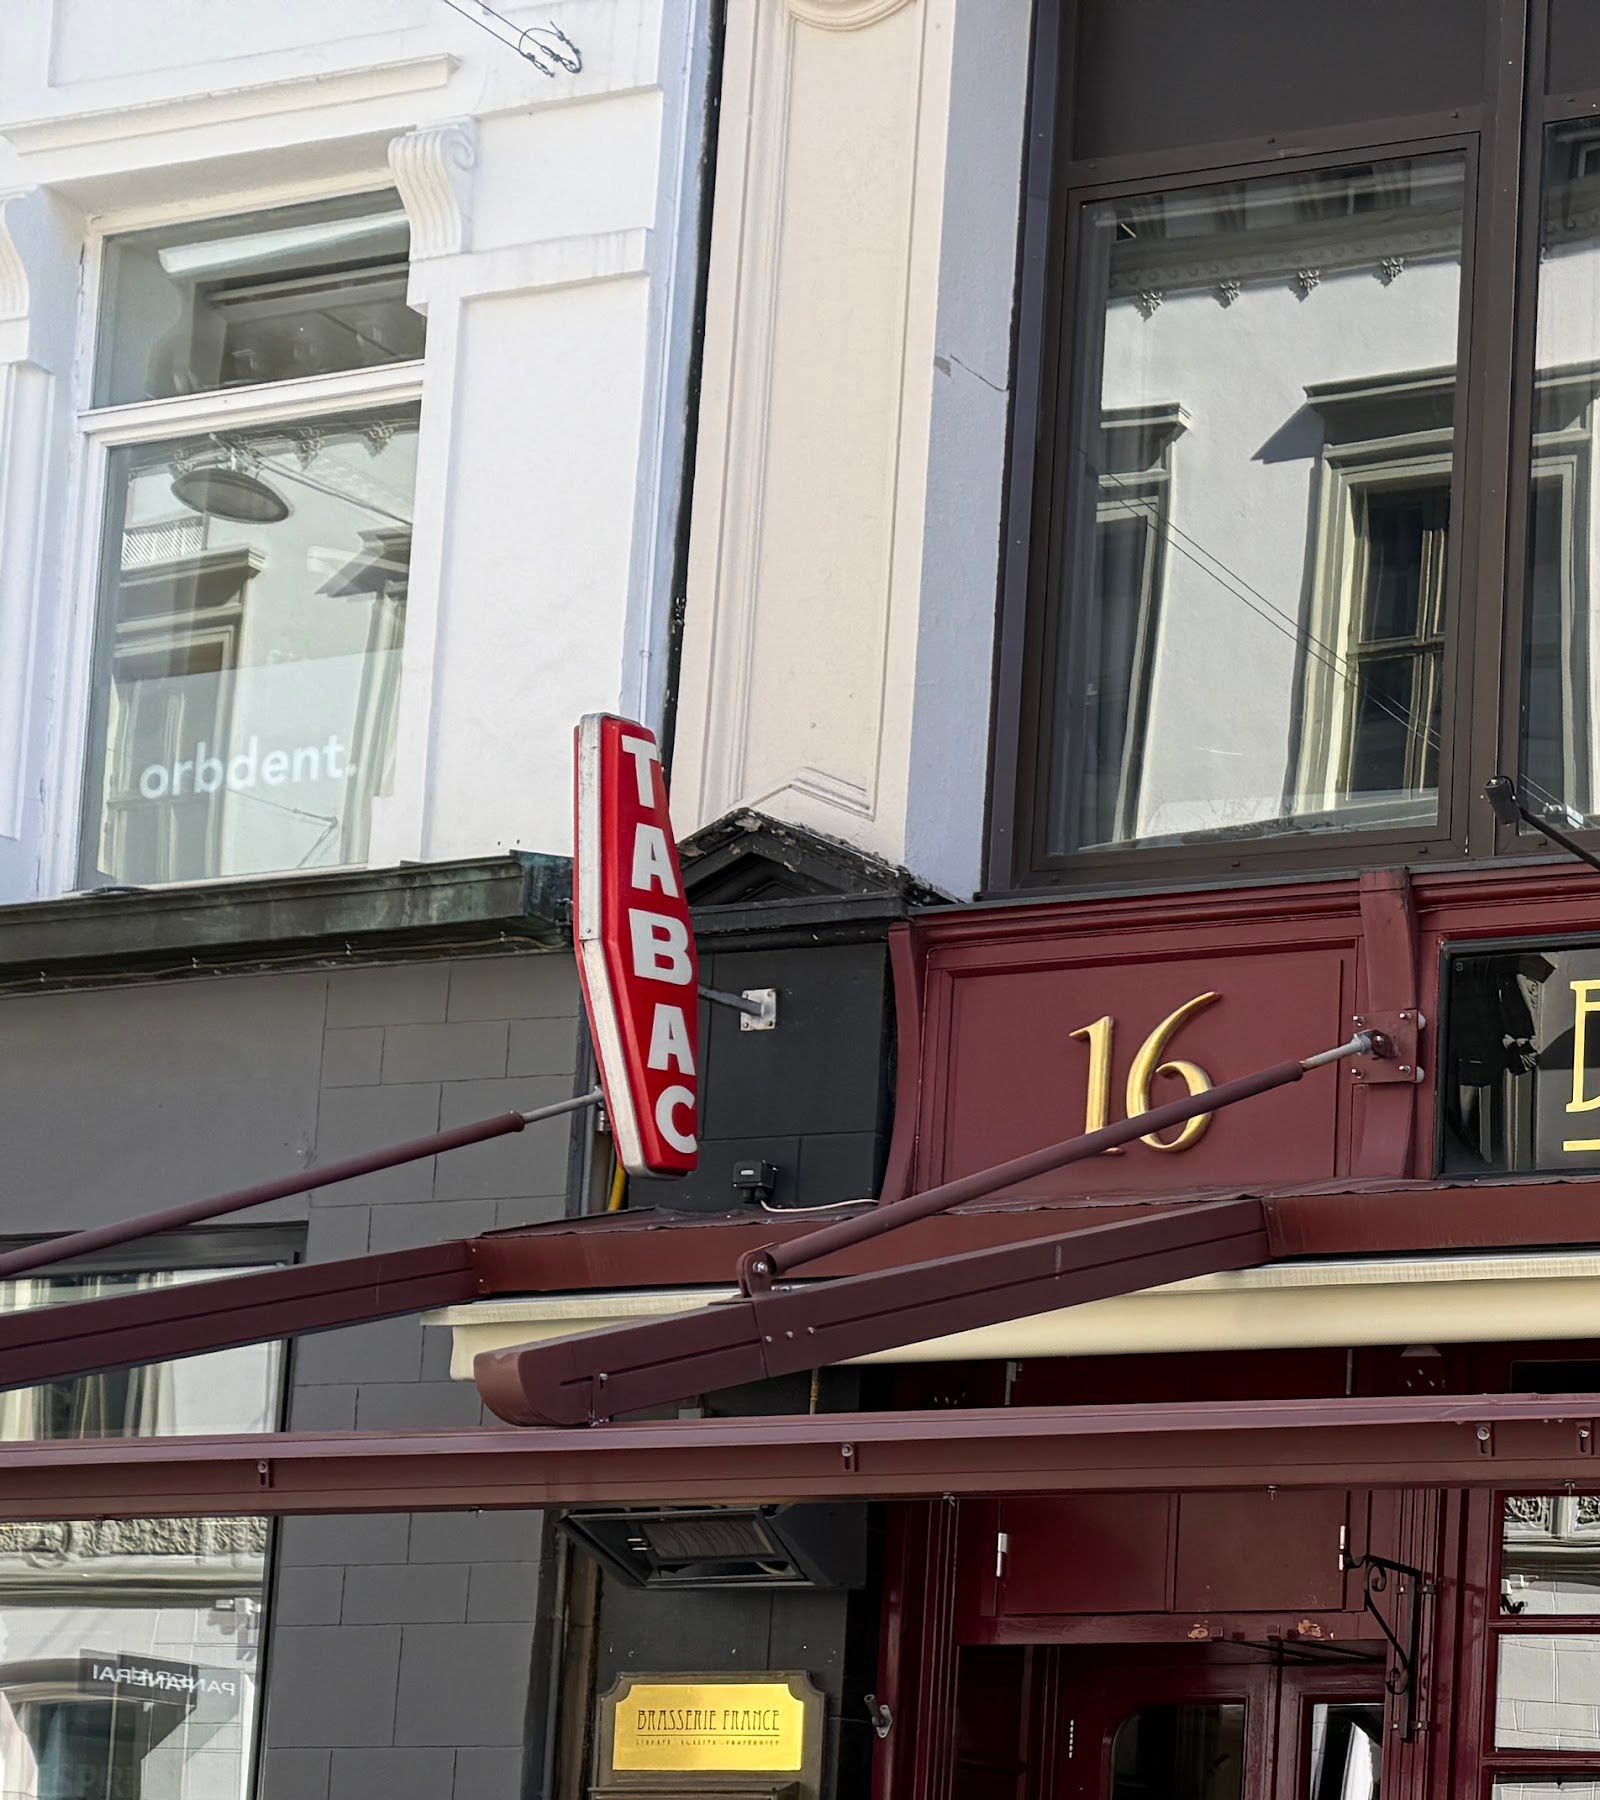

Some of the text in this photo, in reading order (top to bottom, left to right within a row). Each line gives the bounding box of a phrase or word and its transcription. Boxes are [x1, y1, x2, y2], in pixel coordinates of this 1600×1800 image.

[139, 734, 357, 801] orbdent.
[621, 735, 698, 1156] TABAC
[1069, 991, 1222, 1154] 16
[637, 1709, 780, 1730] BRASSERIE FRANCE
